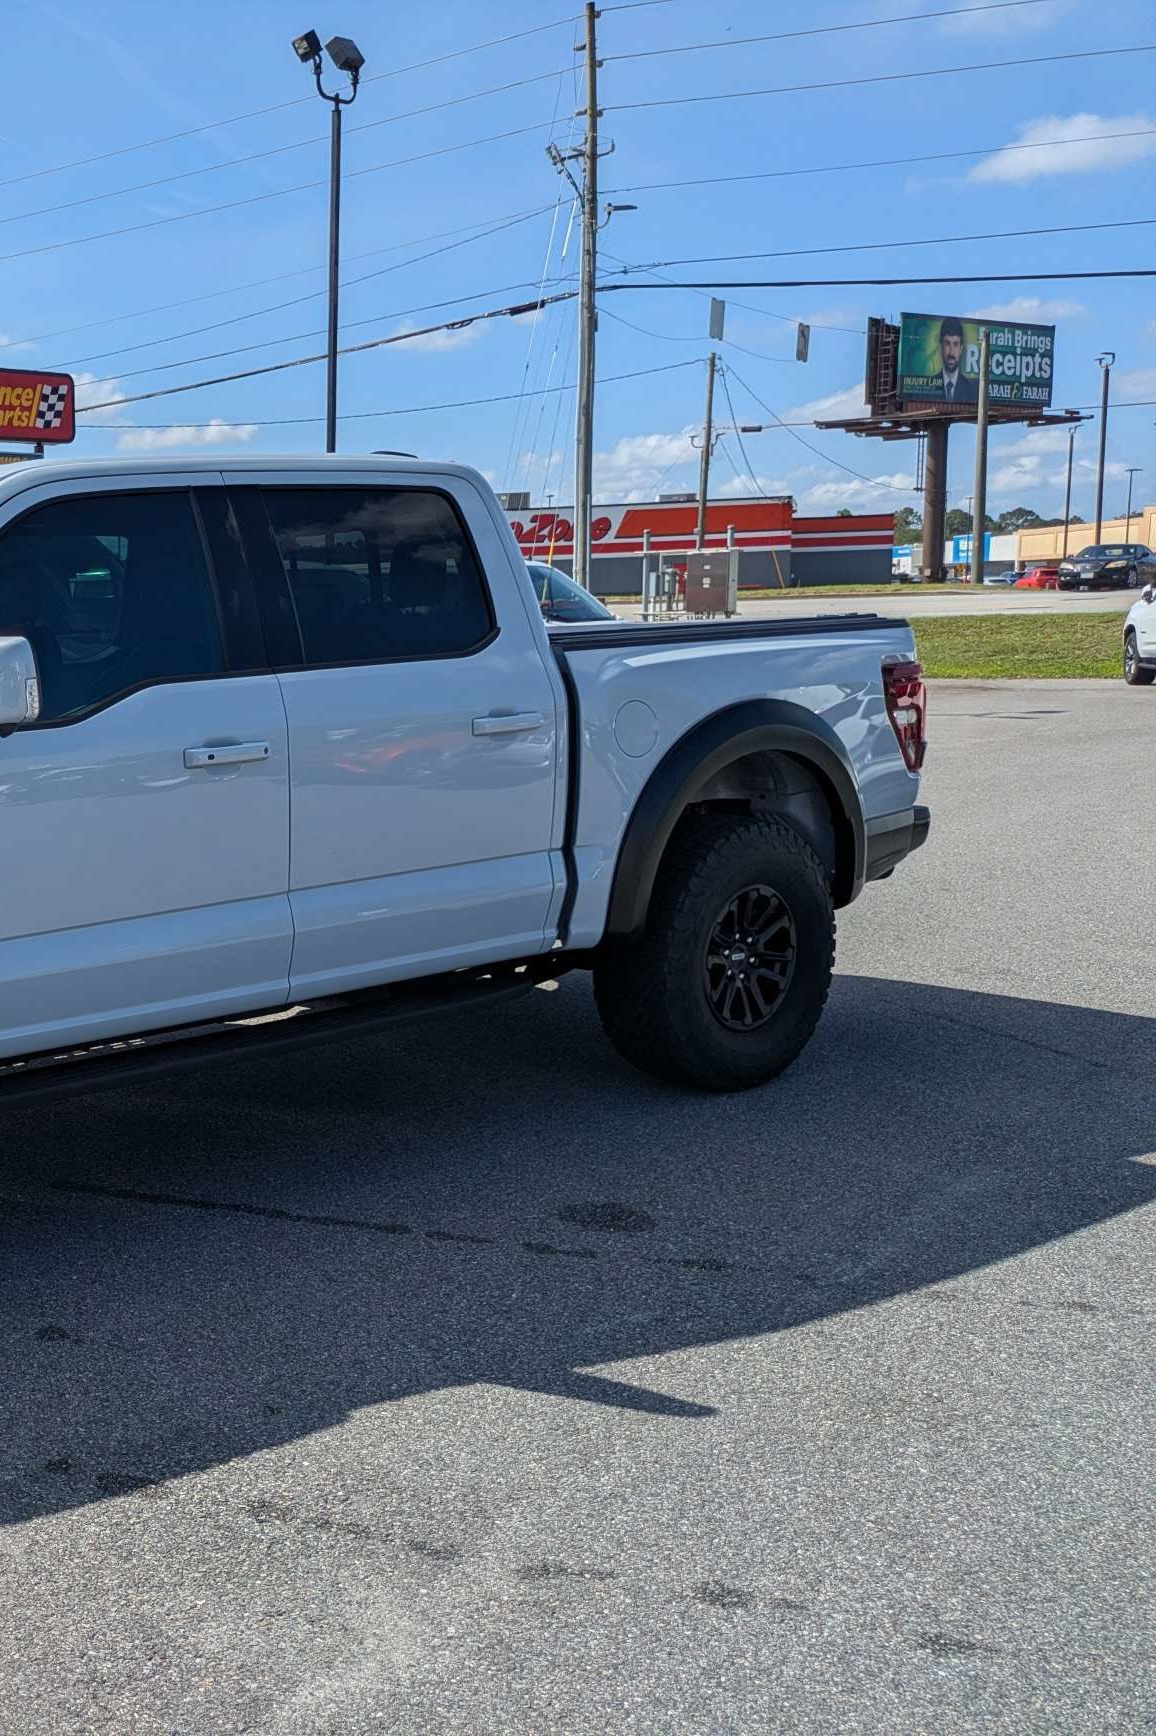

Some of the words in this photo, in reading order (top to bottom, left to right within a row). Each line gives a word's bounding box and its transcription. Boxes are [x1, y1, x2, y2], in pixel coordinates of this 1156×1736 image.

[1014, 330, 1051, 353] Brings
[965, 344, 1051, 383] Rceipts
[903, 376, 927, 386] INJURY
[928, 377, 943, 387] LAW
[988, 384, 1012, 398] ARAH
[1022, 386, 1049, 400] FARAH
